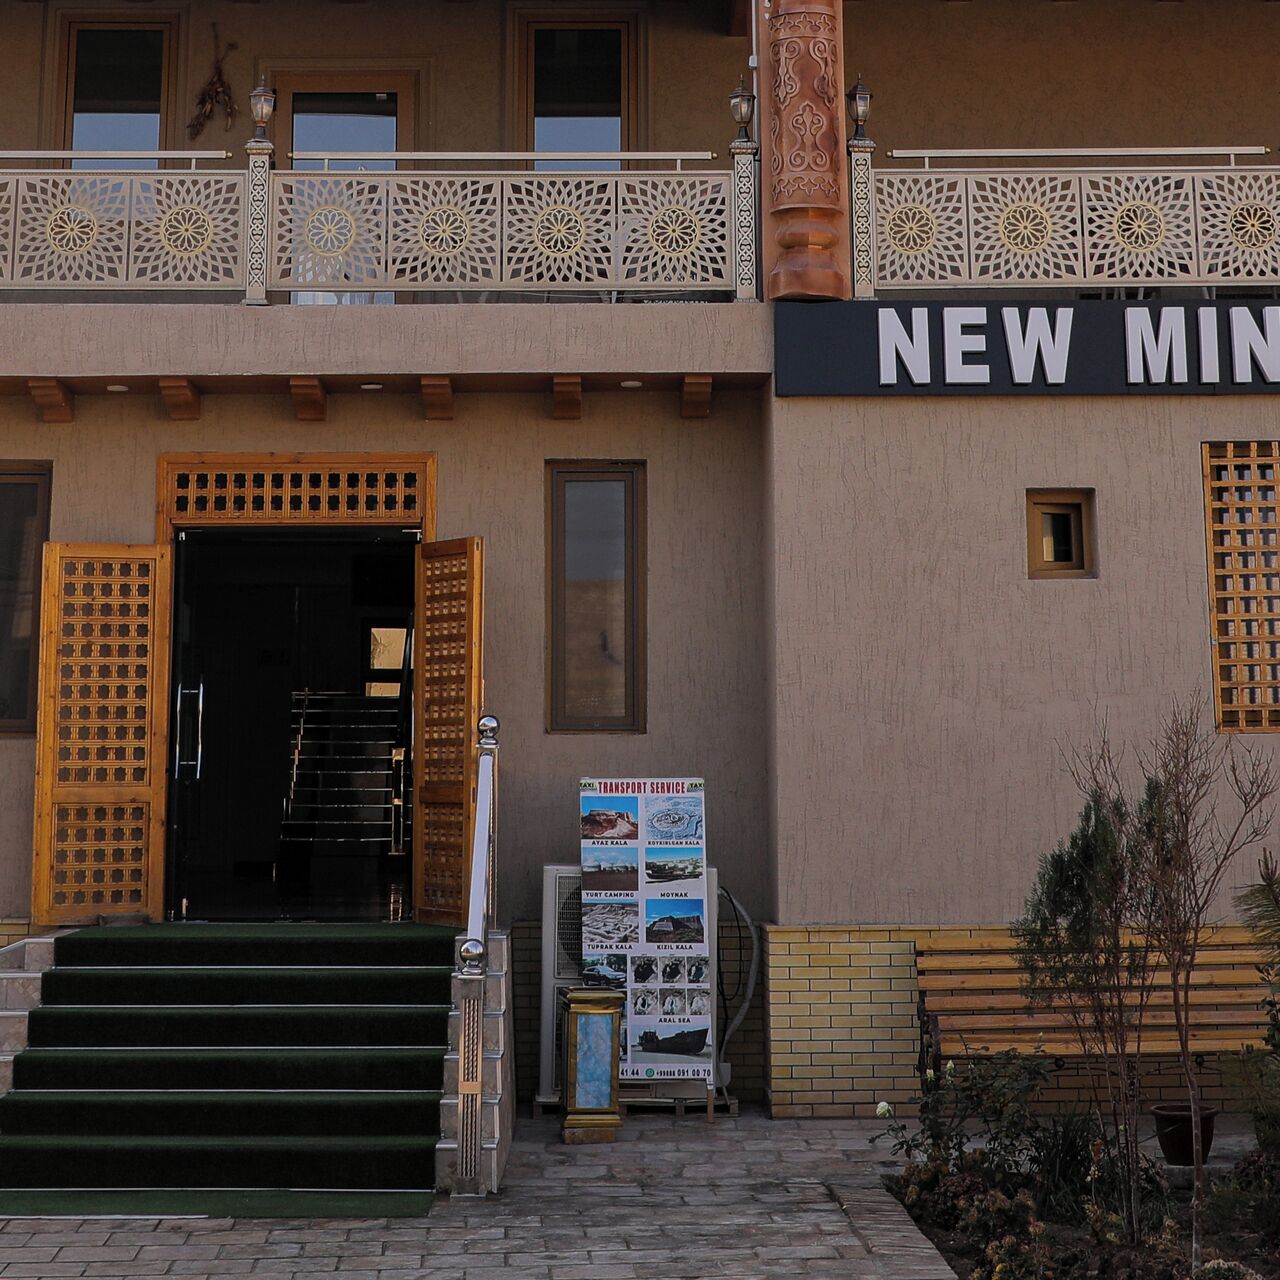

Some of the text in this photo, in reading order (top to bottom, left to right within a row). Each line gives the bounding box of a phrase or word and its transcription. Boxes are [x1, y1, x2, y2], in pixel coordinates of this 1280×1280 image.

[877, 306, 1074, 386] NEW
[598, 781, 686, 794] TRANSPORT SERVICE
[620, 1068, 640, 1076] 41 44
[677, 1068, 689, 1077] 091
[703, 1068, 711, 1077] 70
